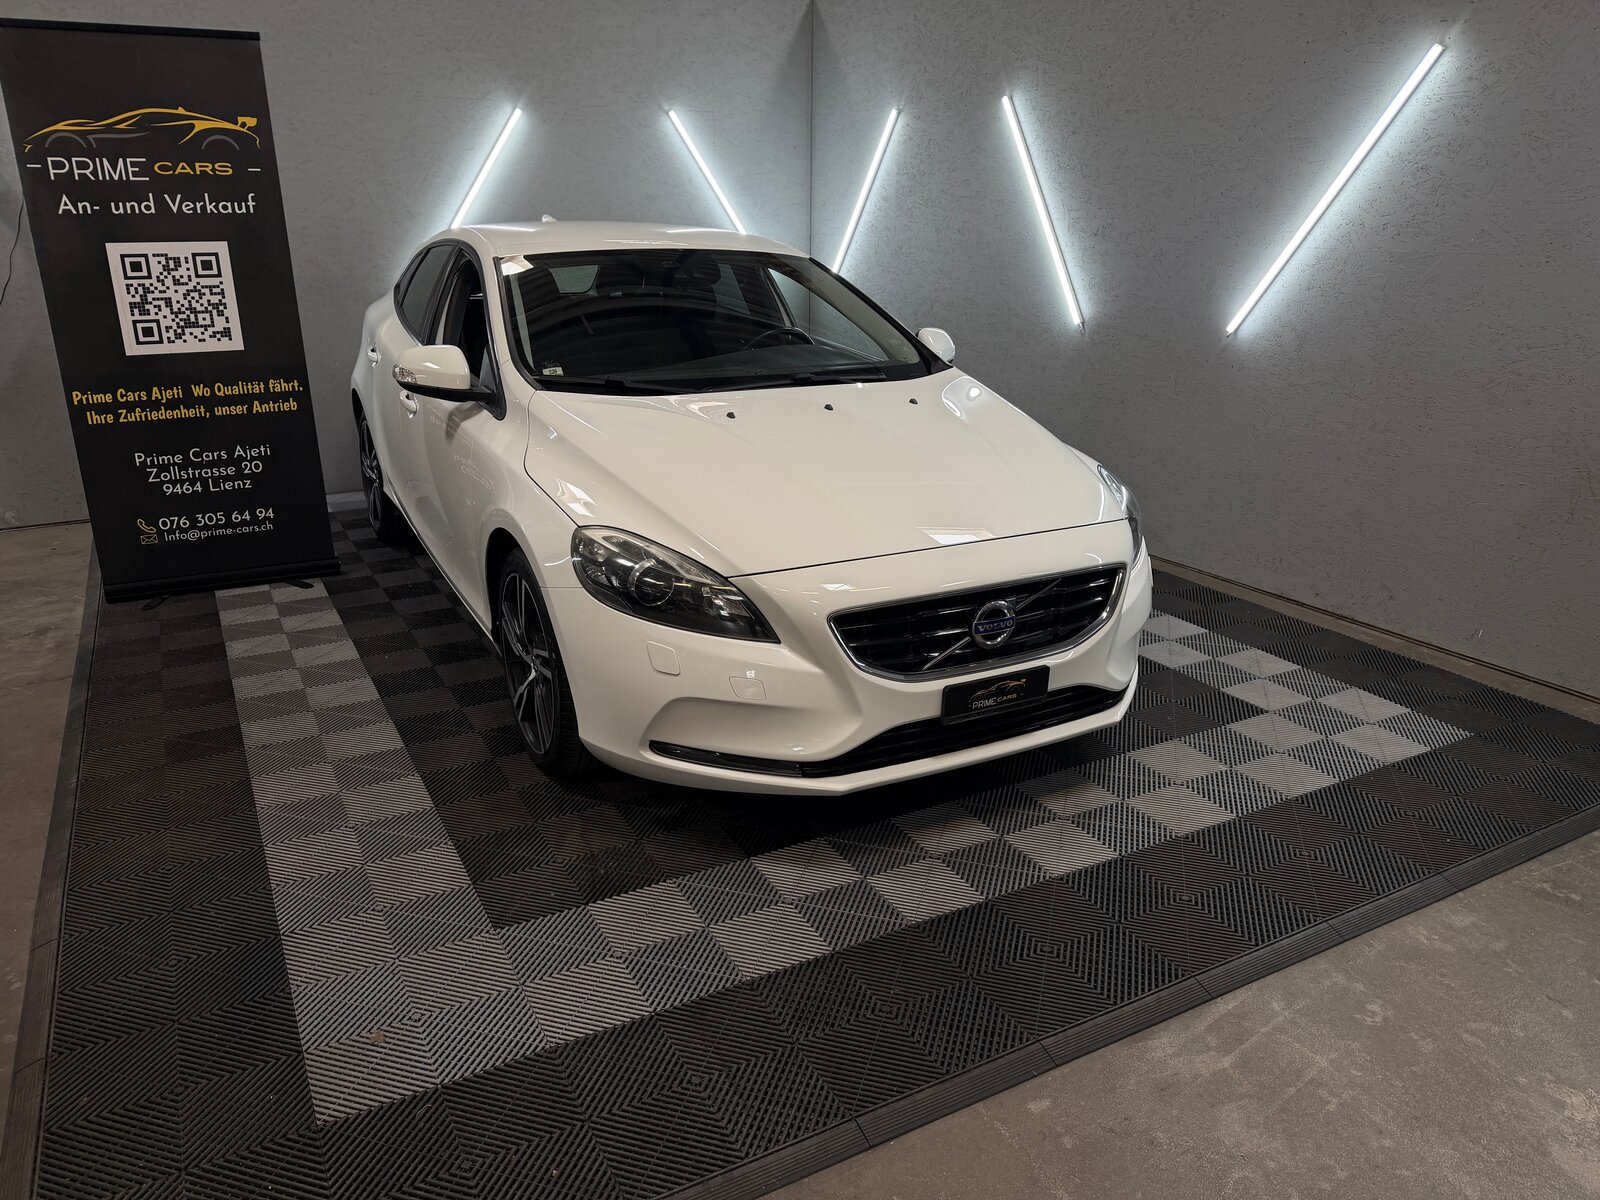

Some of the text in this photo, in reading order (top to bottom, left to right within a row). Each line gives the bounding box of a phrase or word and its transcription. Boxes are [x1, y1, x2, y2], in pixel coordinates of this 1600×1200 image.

[46, 157, 233, 181] PRIME CARS
[58, 193, 256, 214] An- und Verkauf
[72, 379, 303, 405] Prime Cars Ajeti Wo Qualität fährt.
[86, 398, 297, 424] Ihre Zufriedenheit, unser Antrieb
[134, 444, 270, 466] Prime Cars Ajeti
[146, 461, 262, 482] Zollstrasse 20
[163, 478, 252, 495] 9464 Lienz
[159, 507, 274, 529] 076 305 64 94
[164, 521, 273, 541] Info@prime-cars.ch
[977, 620, 1013, 632] VOLVO
[972, 693, 1017, 709] PRIME CARS
